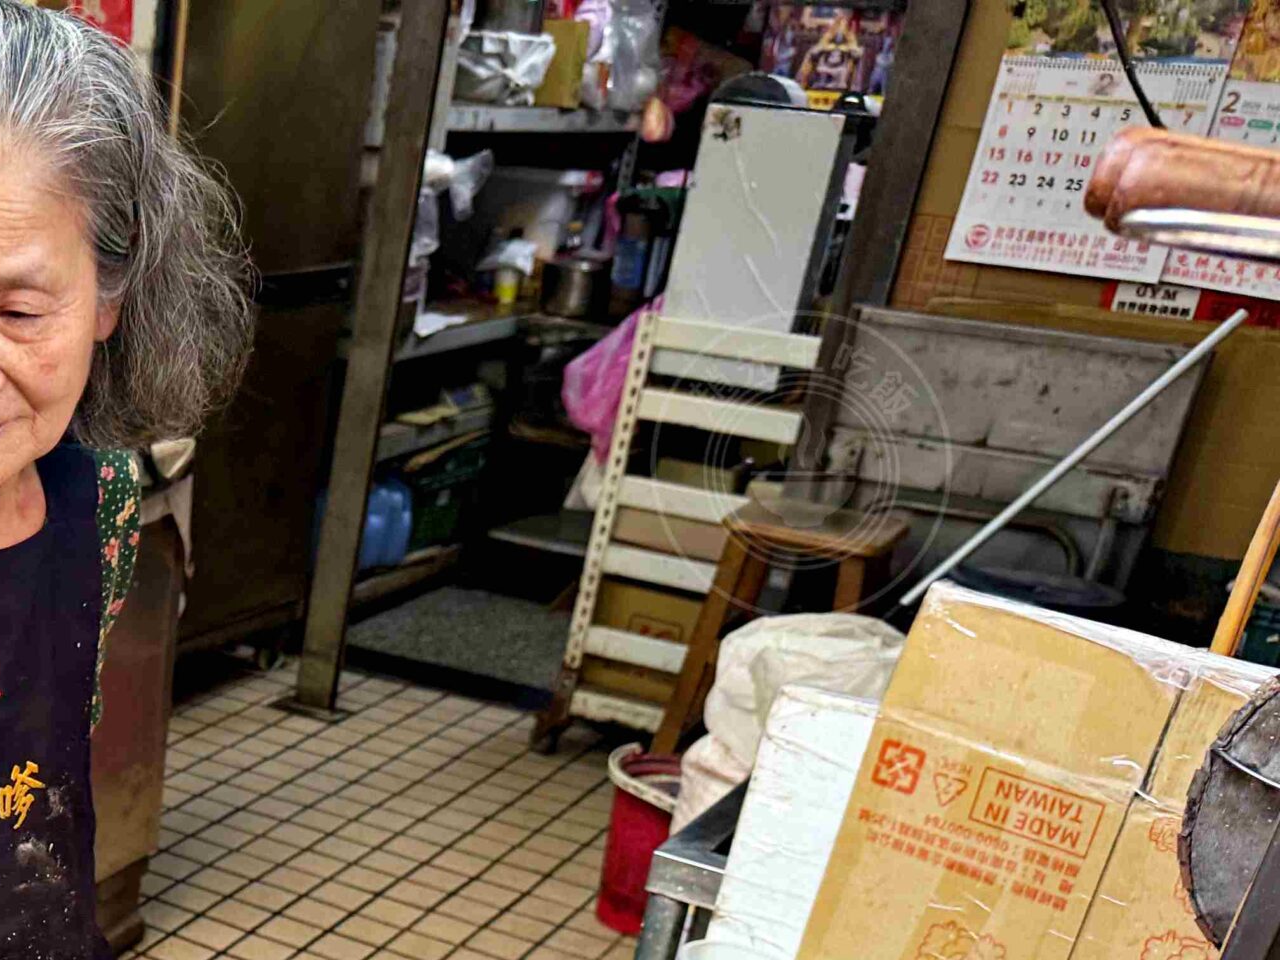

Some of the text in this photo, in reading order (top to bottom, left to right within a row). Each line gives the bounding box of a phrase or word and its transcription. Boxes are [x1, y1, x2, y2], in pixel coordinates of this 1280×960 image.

[1051, 128, 1069, 141] 10
[1081, 130, 1096, 144] 11
[989, 148, 1091, 167] 15 16 17 18
[982, 170, 1083, 191] 22 23 24 25
[995, 778, 1084, 824] TAIWAN
[983, 801, 1082, 849] MADE IN
